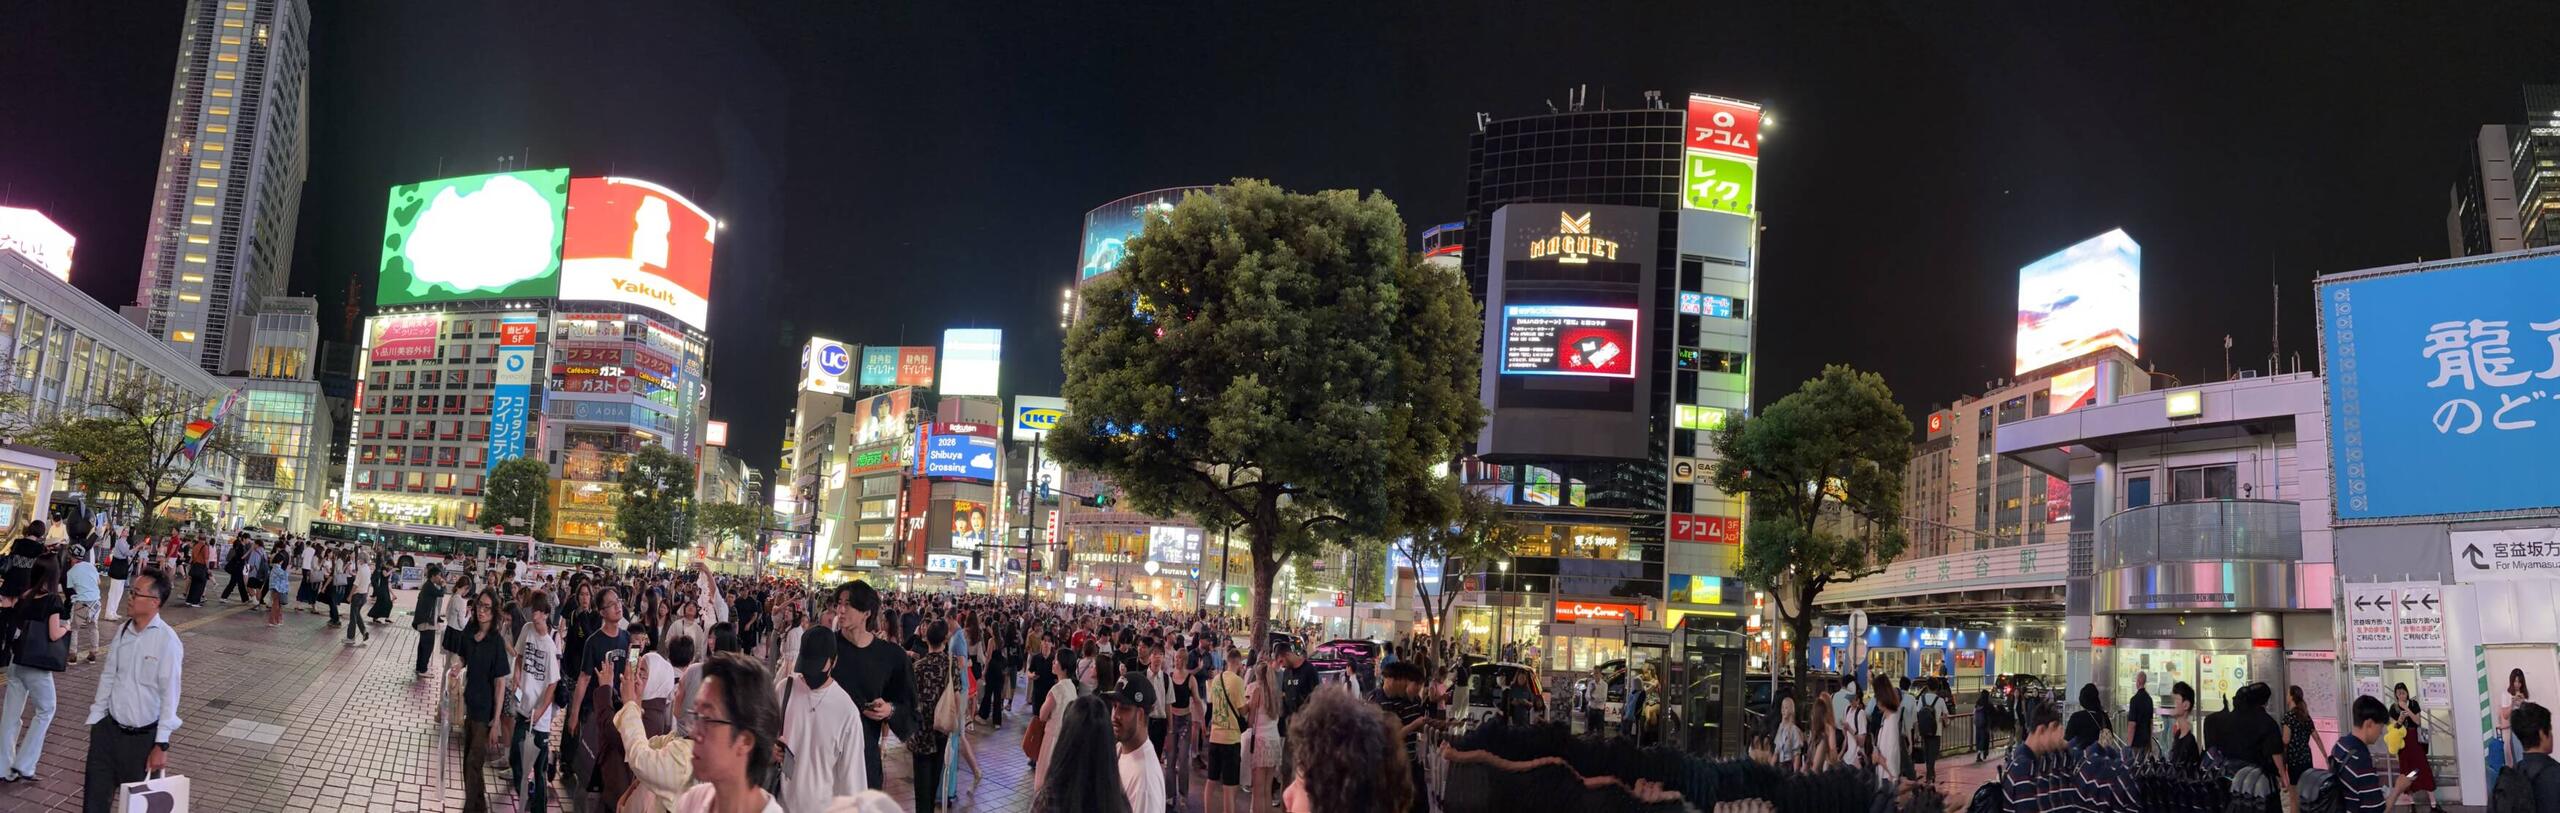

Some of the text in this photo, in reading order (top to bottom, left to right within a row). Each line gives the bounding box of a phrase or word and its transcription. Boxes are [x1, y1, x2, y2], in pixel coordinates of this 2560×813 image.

[1695, 126, 1750, 149] アコム
[1529, 235, 1619, 261] MAGNET
[611, 277, 677, 306] Yakult
[511, 335, 525, 343] 5F
[379, 345, 431, 357] 品川美容外科
[568, 349, 620, 360] プライス
[635, 351, 672, 374] コンタクト
[821, 350, 848, 370] UC
[600, 365, 625, 377] ガスト
[866, 364, 895, 375] ダイレクト
[903, 364, 932, 375] ダイレクト
[552, 379, 564, 388] 7F
[582, 379, 615, 392] ガスト
[661, 377, 678, 391] ガスト
[2432, 390, 2560, 434] のど
[1024, 413, 1058, 424] IKE
[949, 423, 977, 433] Rakuten
[930, 450, 963, 463] Shibuya
[929, 462, 967, 474] Crossing
[1697, 463, 1718, 471] EAS
[378, 502, 432, 517] サンドラッグ
[1678, 520, 1739, 537] アコム 3F
[2496, 561, 2510, 570] For
[1161, 567, 1188, 577] TSUTAYA
